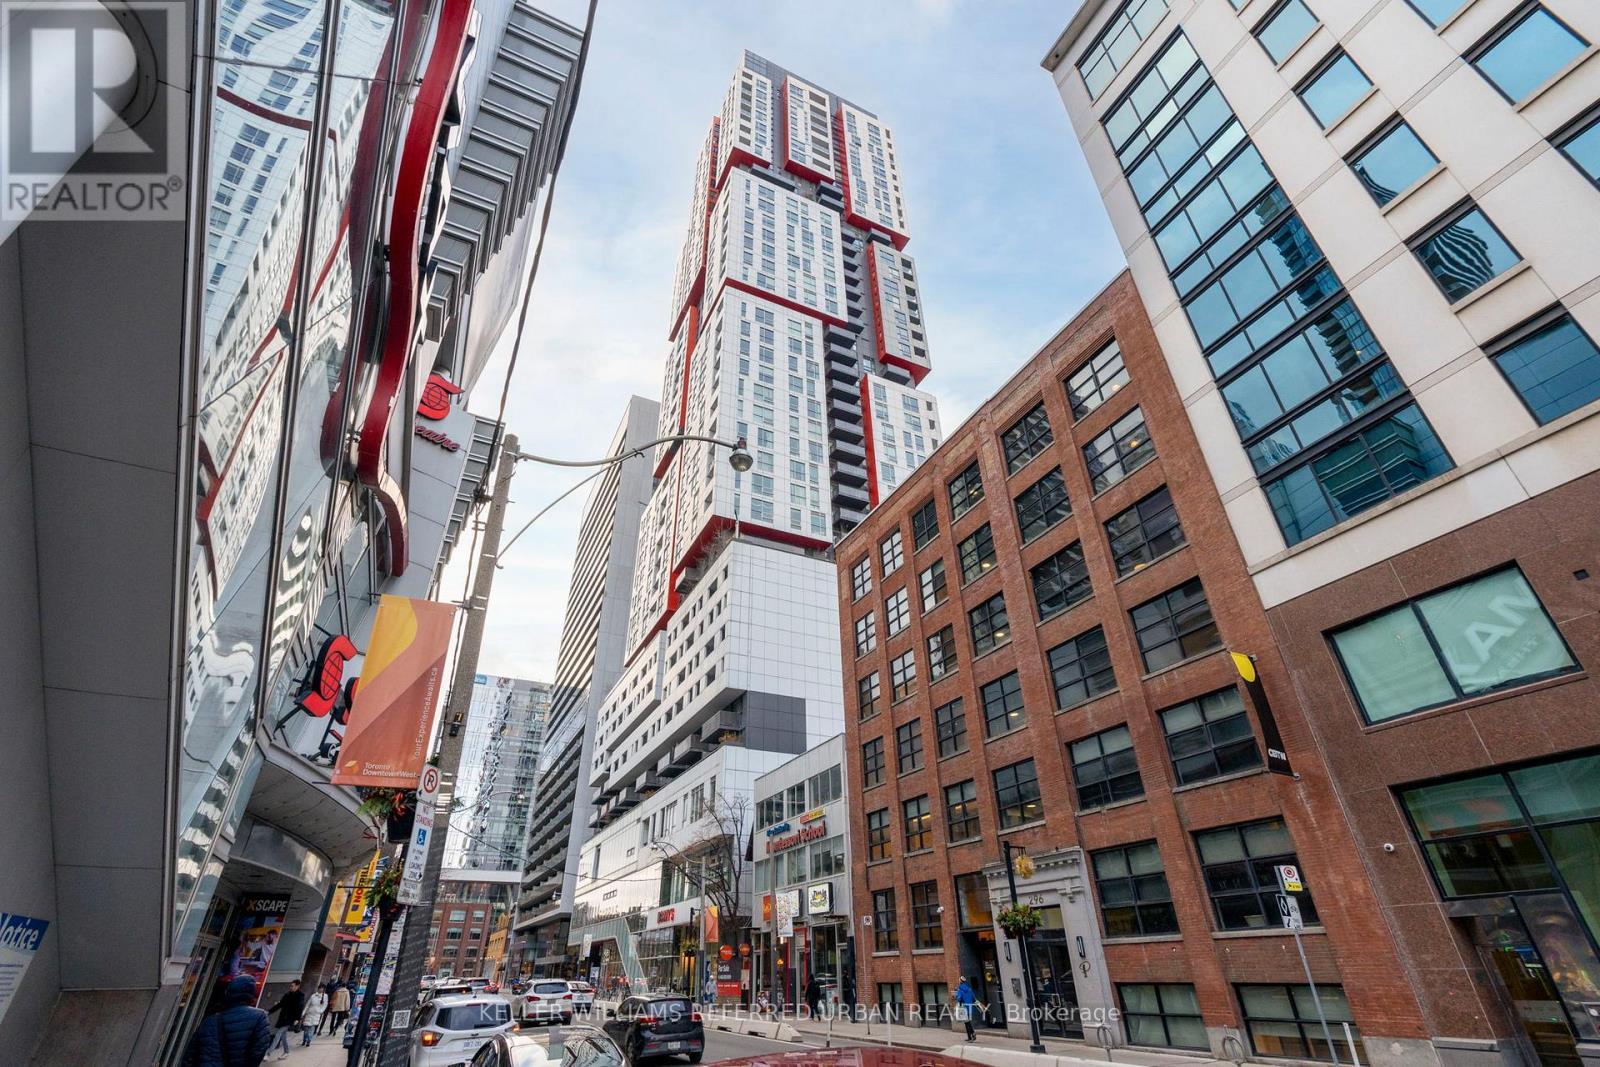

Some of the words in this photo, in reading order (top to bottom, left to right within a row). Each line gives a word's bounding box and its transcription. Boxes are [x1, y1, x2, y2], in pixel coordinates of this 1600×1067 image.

[365, 762, 391, 770] Toronto
[1029, 895, 1044, 905] 296
[246, 899, 288, 912] XSCAPE
